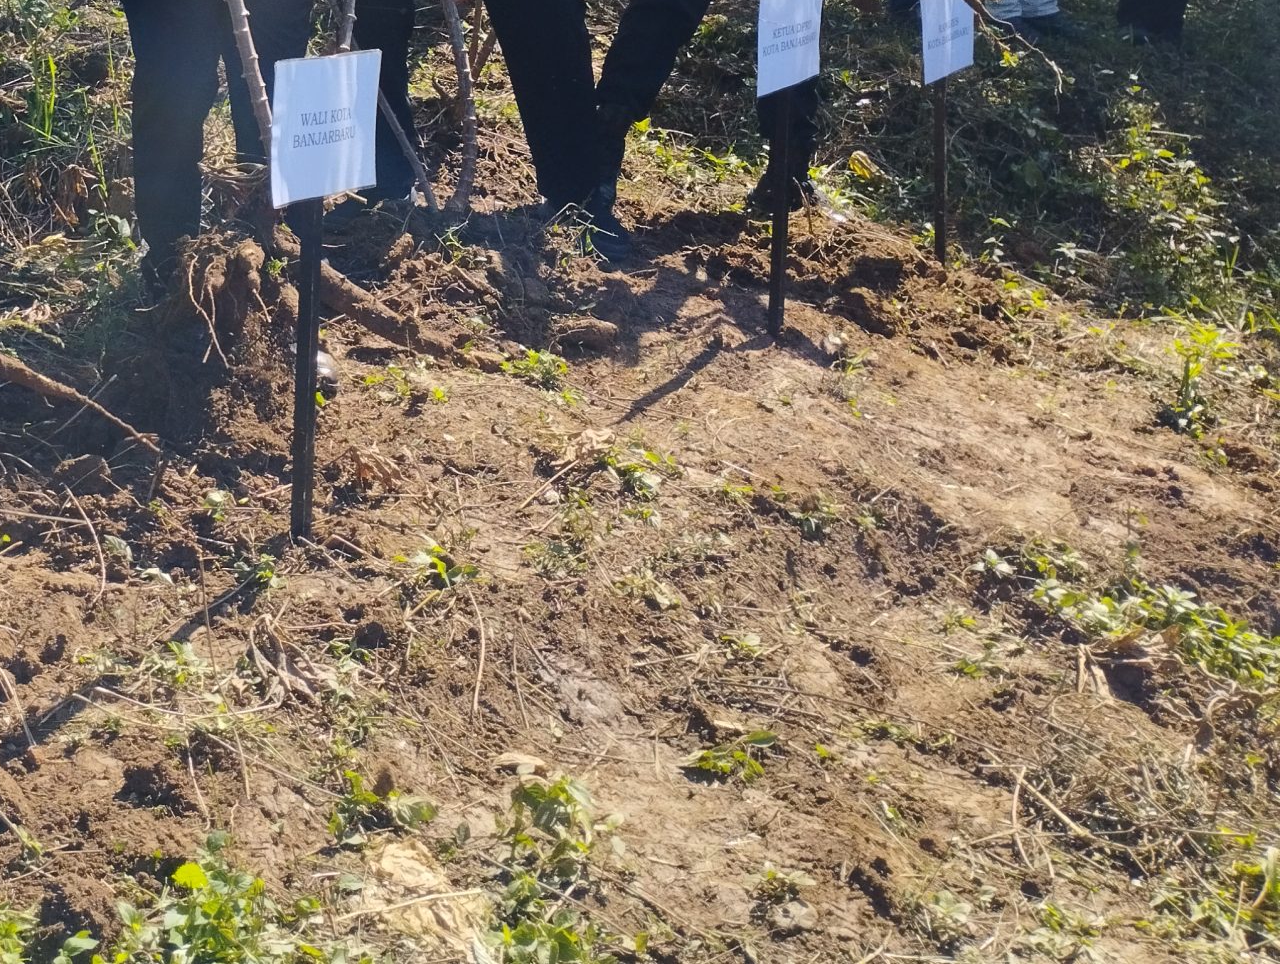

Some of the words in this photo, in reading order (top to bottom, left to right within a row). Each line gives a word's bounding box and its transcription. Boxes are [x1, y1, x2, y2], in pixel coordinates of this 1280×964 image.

[301, 111, 328, 126] WALI
[331, 107, 352, 124] KOTA
[293, 125, 356, 148] BANJARBARU
